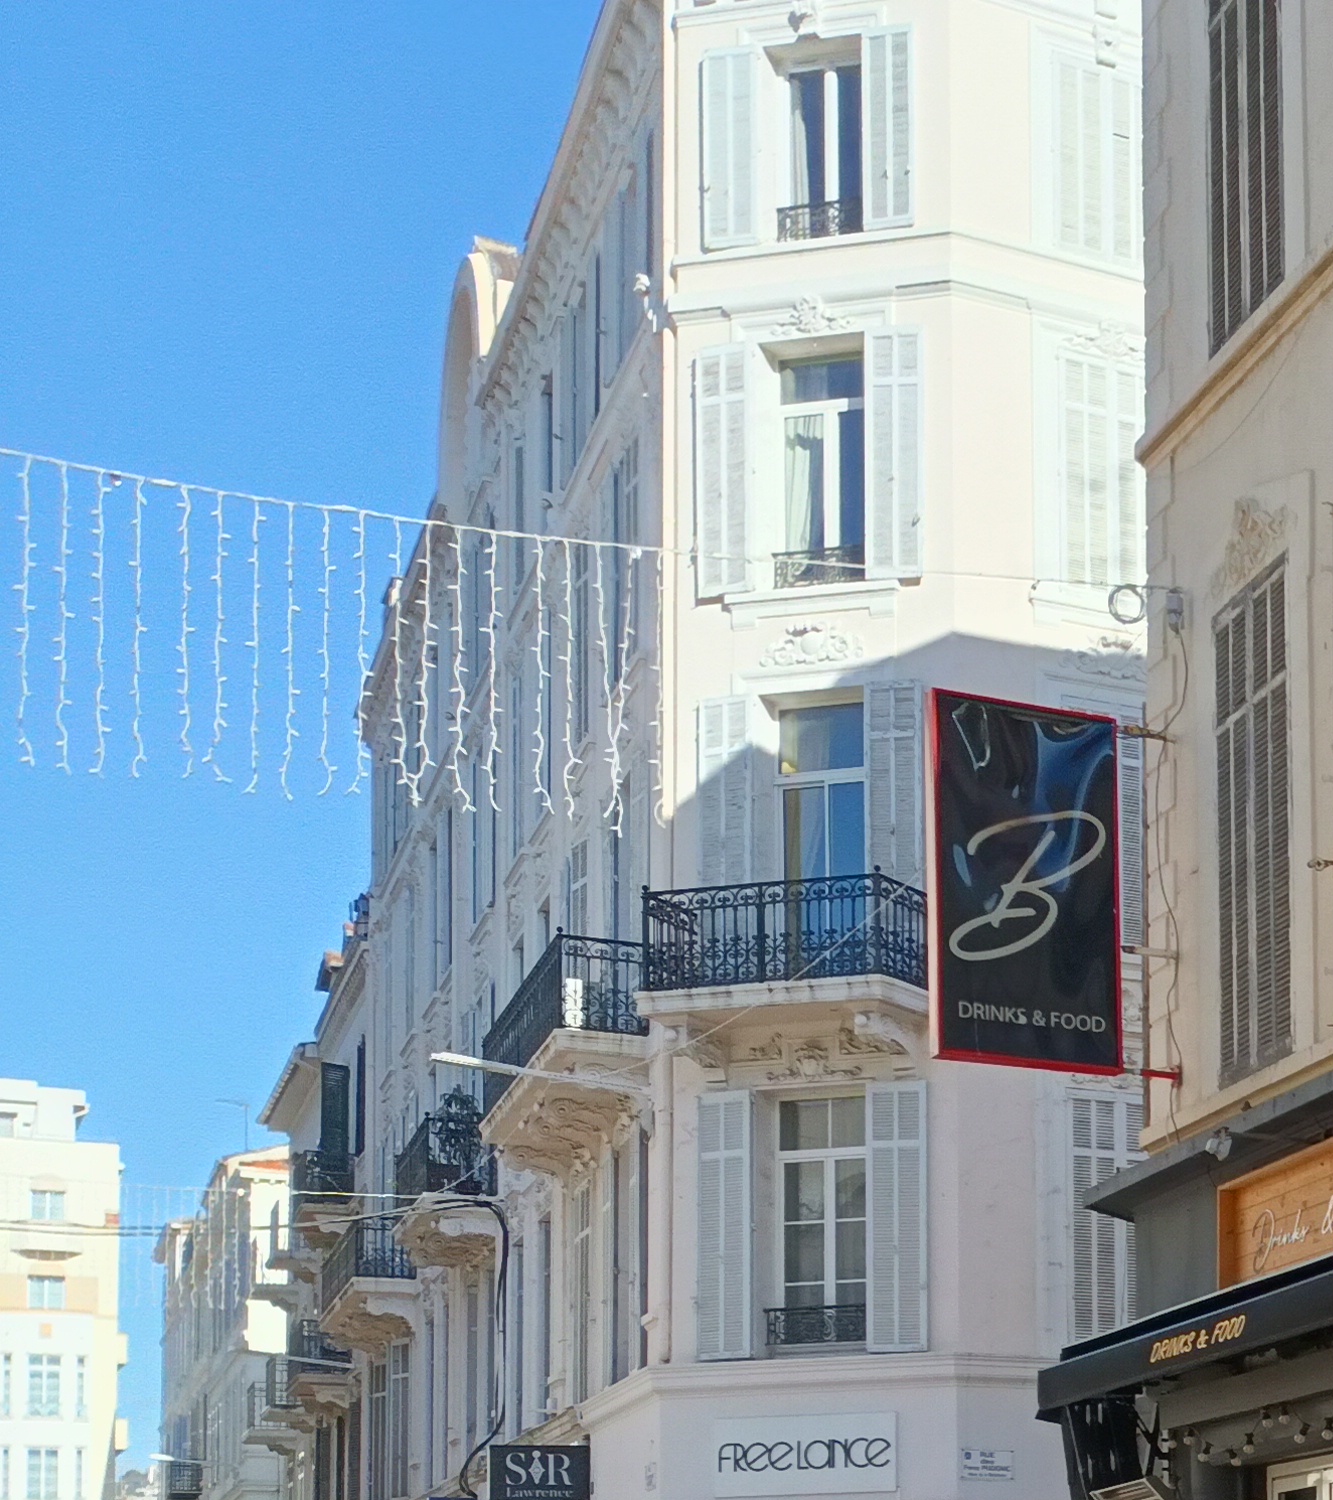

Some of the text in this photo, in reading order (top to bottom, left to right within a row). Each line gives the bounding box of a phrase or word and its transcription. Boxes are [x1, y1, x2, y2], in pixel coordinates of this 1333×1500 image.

[949, 810, 1106, 961] B
[958, 1000, 1106, 1033] DRINKS & FOOD
[1252, 1208, 1310, 1274] Drinks
[1149, 1315, 1246, 1363] DRINKS & FOOD
[506, 1487, 574, 1498] Lawrence
